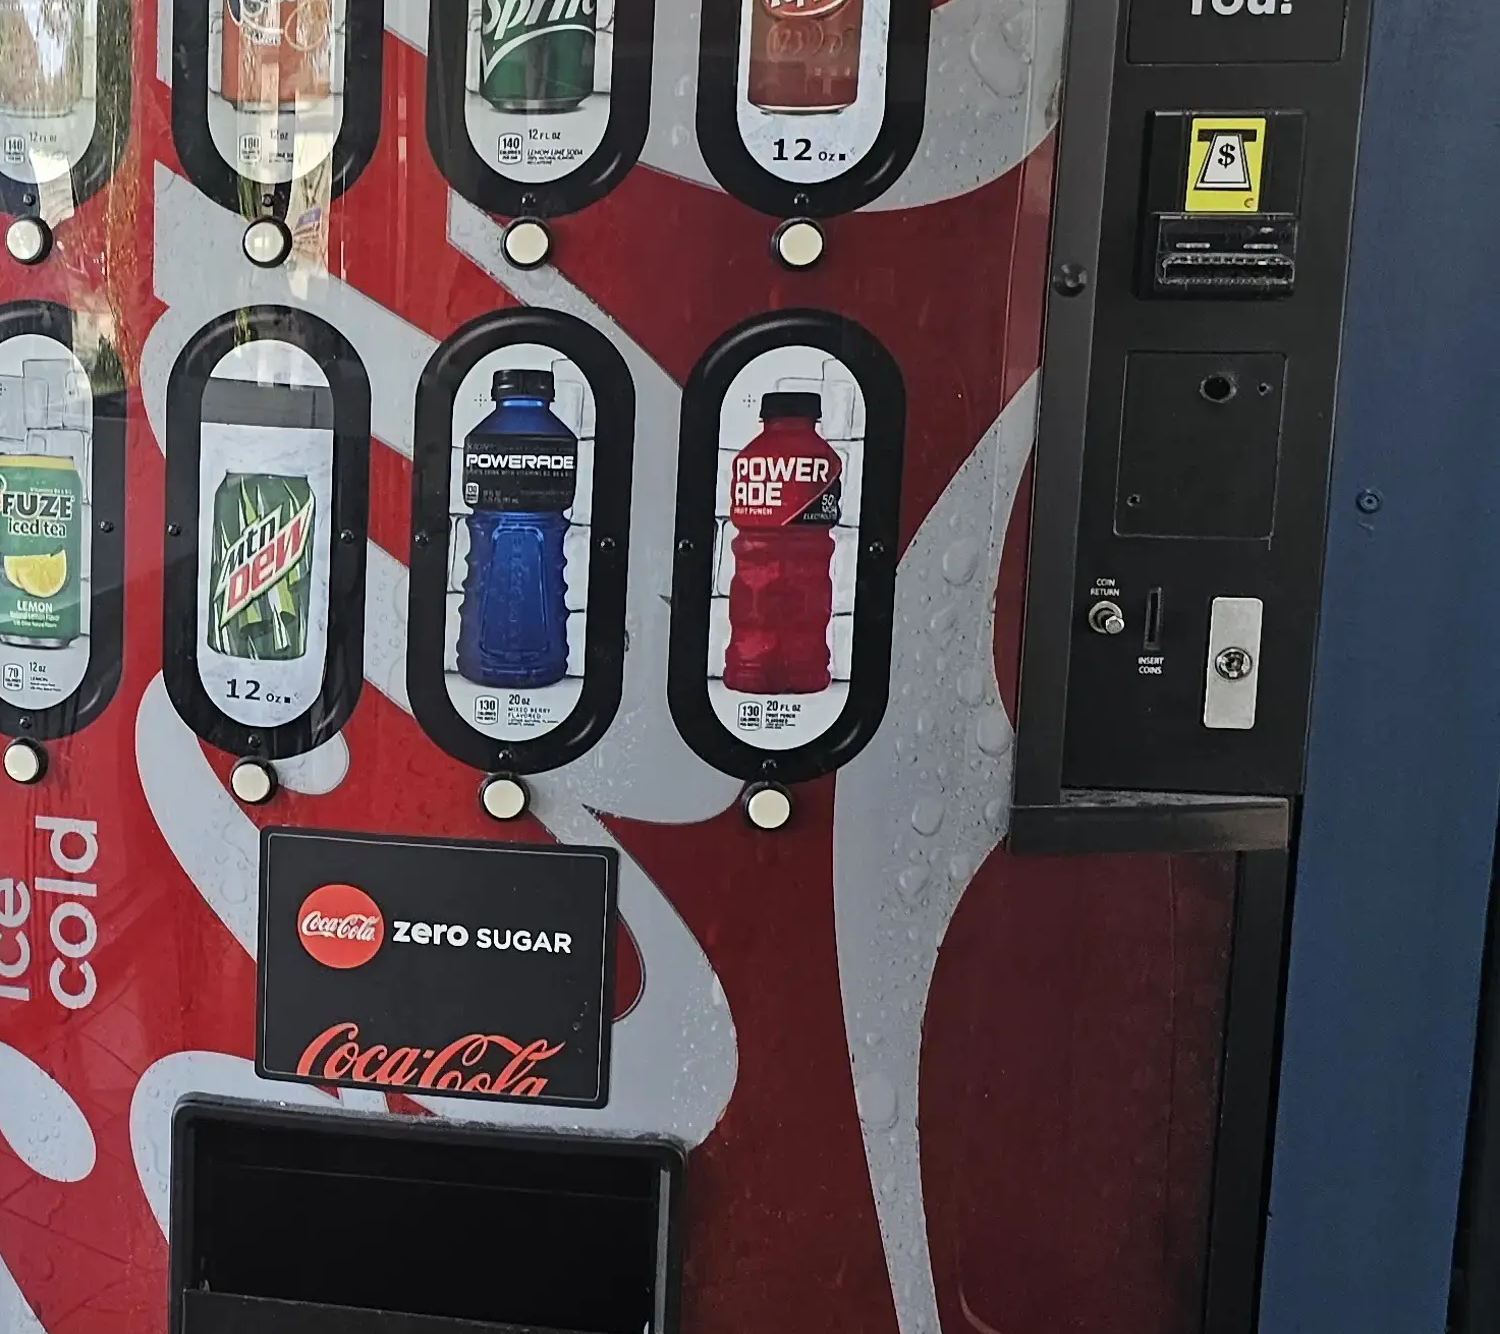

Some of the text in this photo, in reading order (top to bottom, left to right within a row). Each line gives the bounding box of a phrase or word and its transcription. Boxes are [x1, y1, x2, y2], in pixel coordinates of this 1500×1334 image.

[528, 129, 561, 140] 12 FL OZ
[8, 138, 23, 151] 140
[503, 137, 520, 149] 140
[772, 138, 812, 162] 12
[466, 453, 574, 469] POWERADE
[736, 457, 829, 482] POWER
[735, 481, 782, 506] ADE
[2, 492, 72, 520] FUZE
[8, 517, 67, 537] iced tea
[1096, 578, 1116, 587] COIN
[1090, 587, 1120, 596] RETURN
[16, 599, 53, 613] LEMON
[29, 662, 37, 672] 12
[1138, 657, 1164, 665] INSERT
[8, 667, 19, 678] 70
[1138, 666, 1162, 674] COINS
[226, 678, 261, 701] 12
[480, 700, 496, 710] 130
[508, 694, 520, 705] 20
[742, 705, 760, 717] 130
[766, 700, 801, 712] 20 FL OZ
[34, 815, 99, 1010] cold
[301, 910, 572, 954] Coca-Cola zero SUGAR
